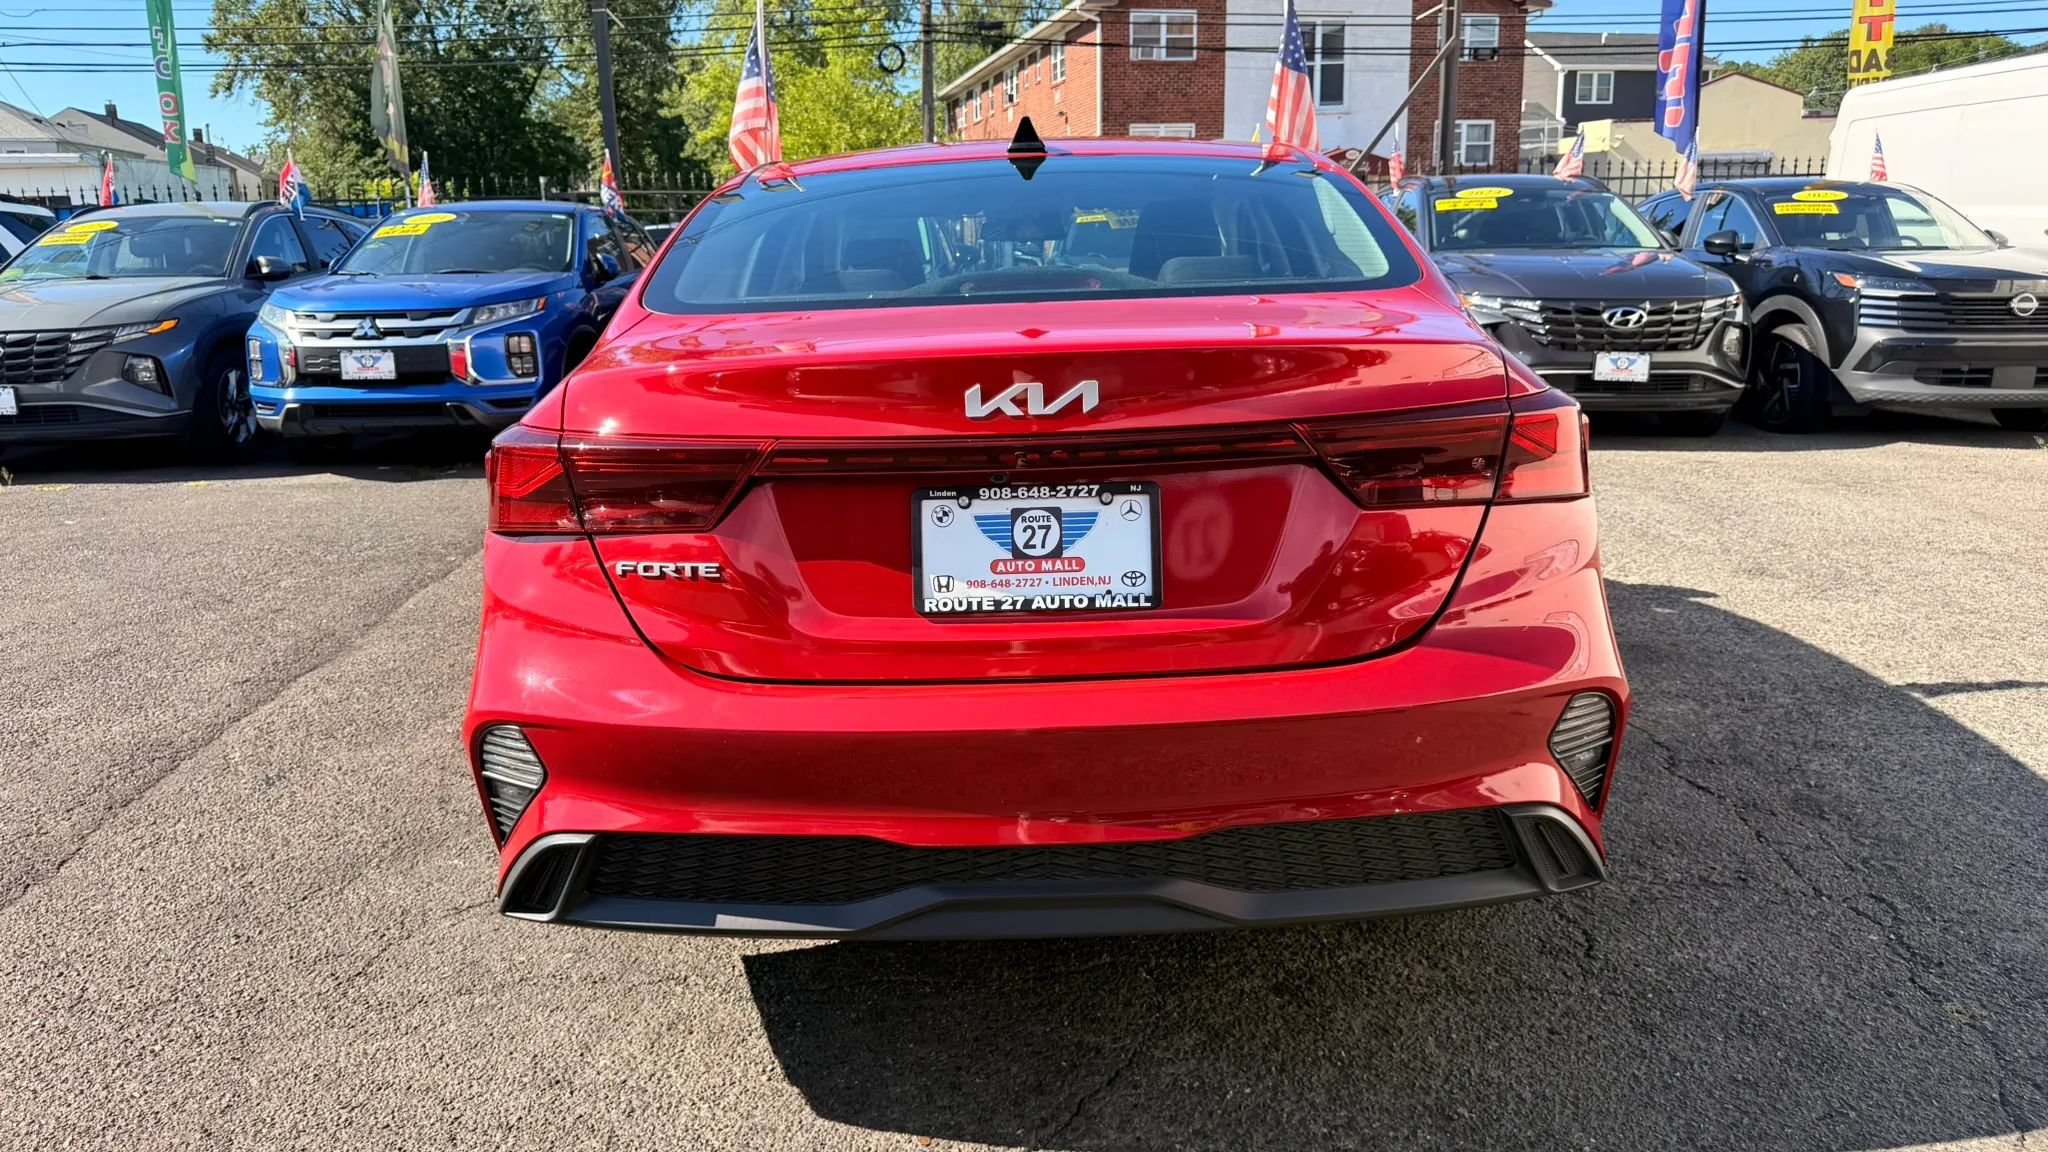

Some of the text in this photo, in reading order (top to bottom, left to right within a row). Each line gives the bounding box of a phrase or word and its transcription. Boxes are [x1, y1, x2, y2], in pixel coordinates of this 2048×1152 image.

[965, 380, 1099, 417] KIA
[979, 485, 1100, 500] 908-648-2727
[1021, 515, 1052, 524] ROUTE
[1022, 525, 1052, 550] 27
[615, 561, 721, 578] FORTE
[996, 559, 1080, 573] AUTO MALL
[966, 576, 1112, 589] 908-648-2727 LINDEN,NJ
[923, 593, 1152, 612] ROUTE 27 AUTO MALL
